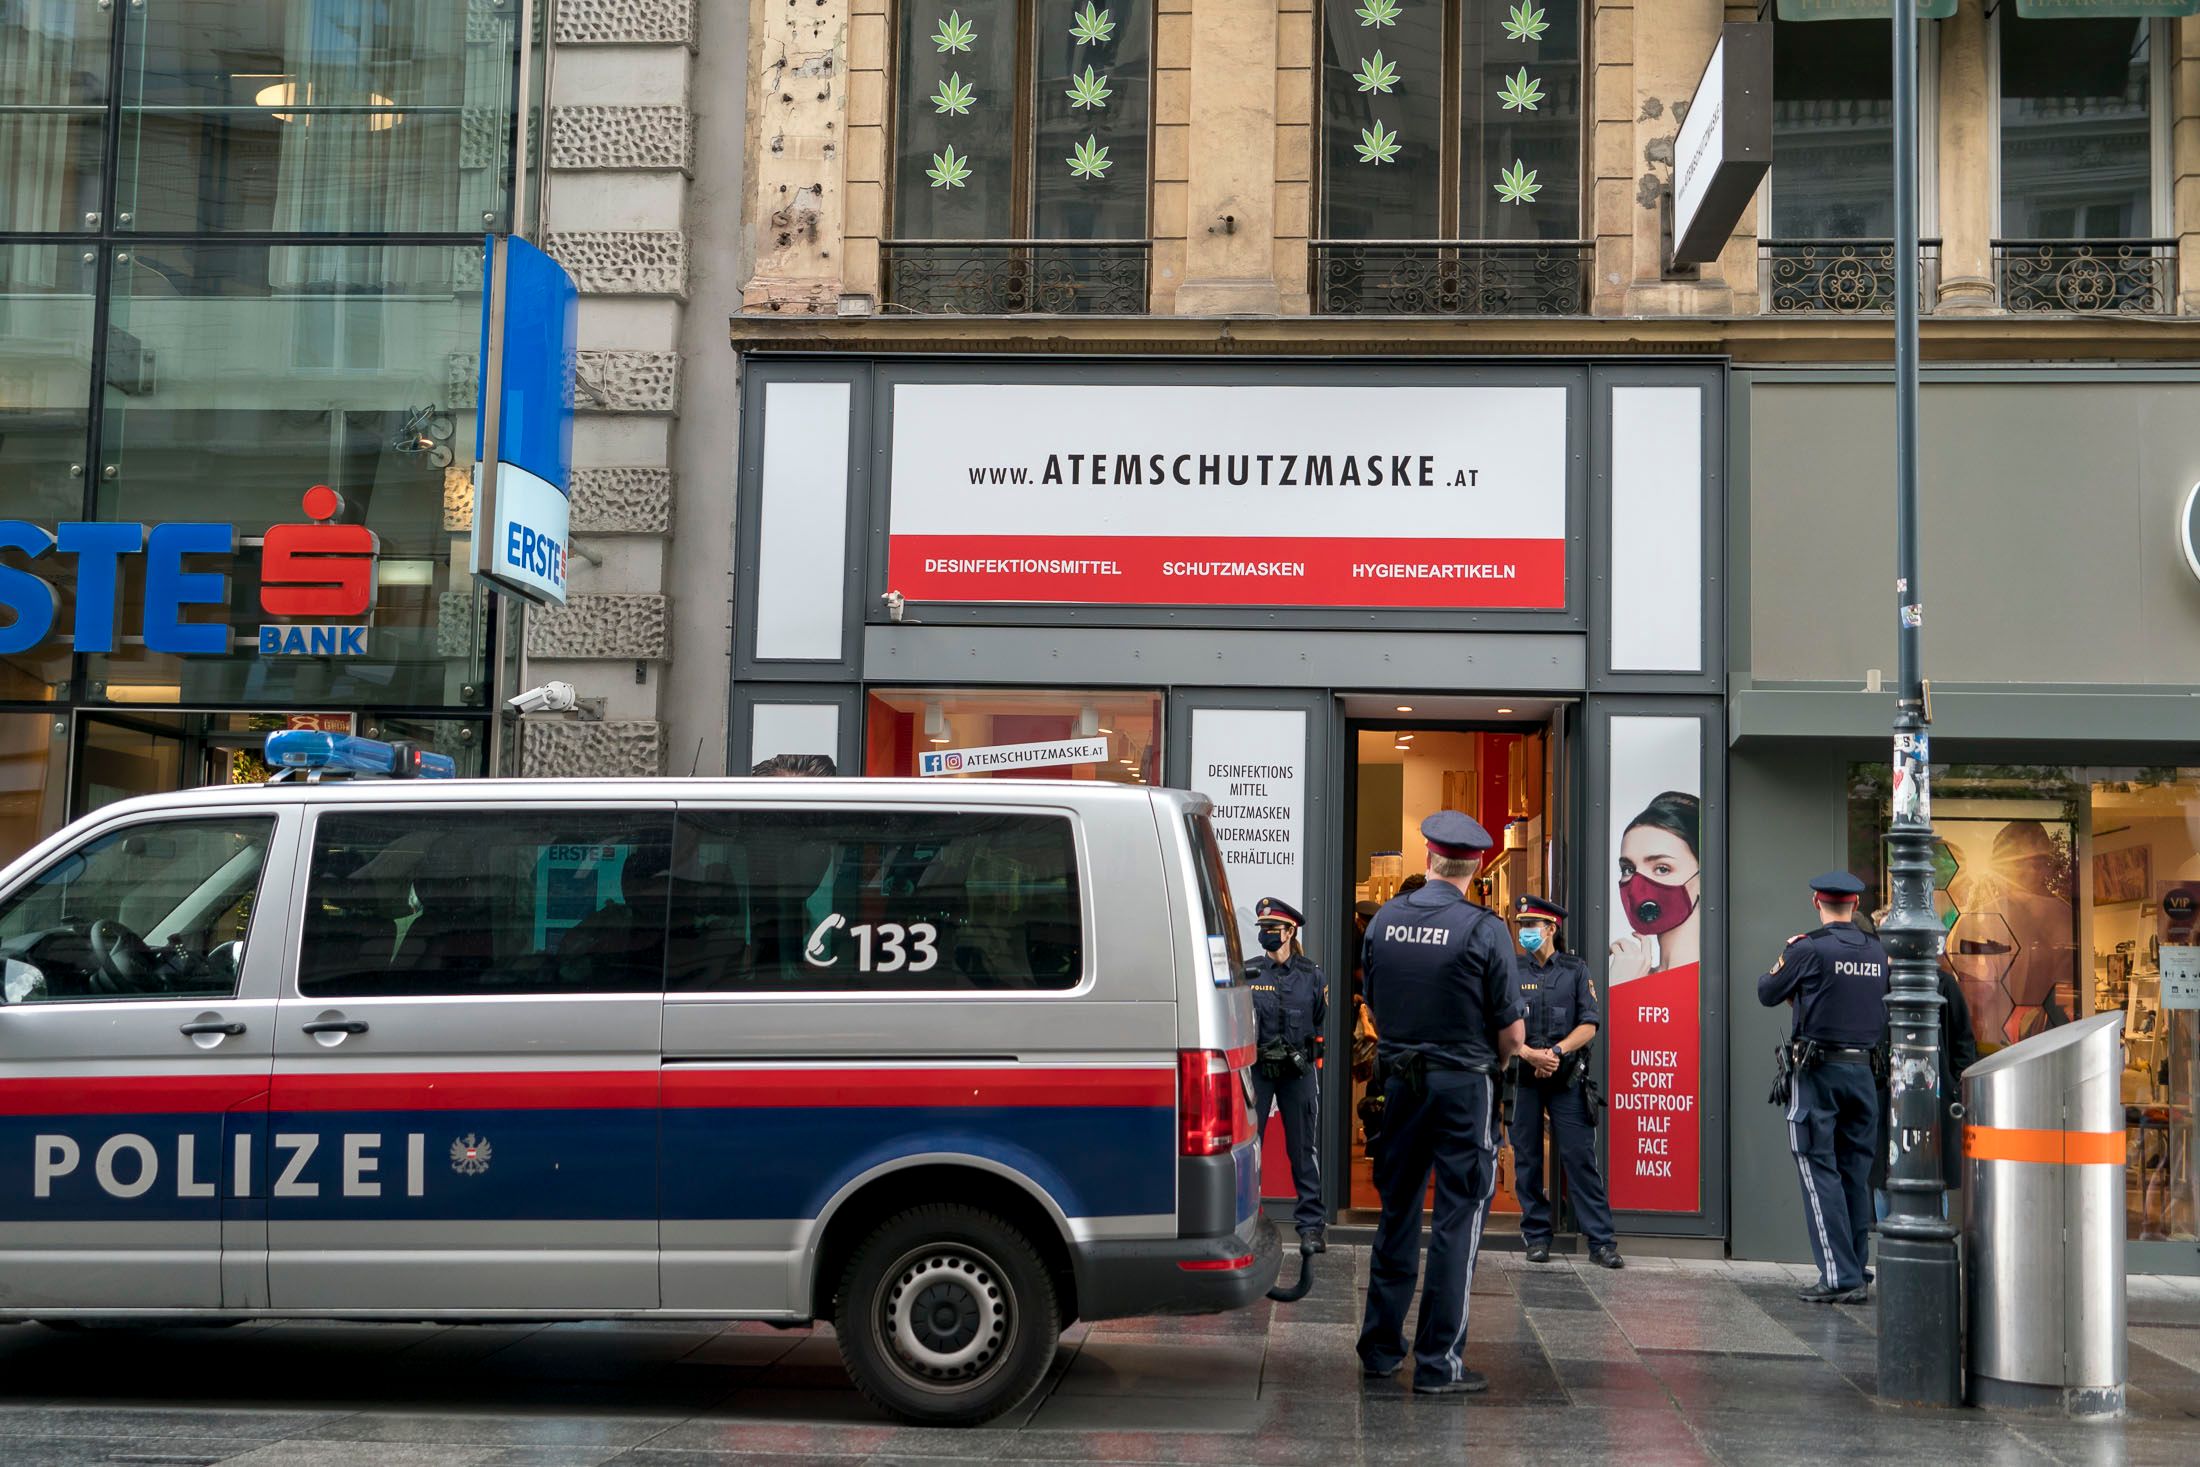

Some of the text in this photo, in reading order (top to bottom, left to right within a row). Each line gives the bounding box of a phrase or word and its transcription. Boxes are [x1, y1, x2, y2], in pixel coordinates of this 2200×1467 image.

[507, 521, 560, 586] ERSTE
[924, 559, 1516, 579] DESINFEKTIONSMITTEL SCHUTZMASKEN HYGIENEARTIKELN
[259, 626, 365, 655] BANK
[966, 745, 1104, 767] ATEMSCHUTZMASKE.AT
[1208, 764, 1294, 779] DESINFEKTIONS
[1229, 783, 1269, 797] MITTEL
[1211, 805, 1291, 820] CHUTZMASKEN
[1214, 827, 1290, 842] NDERMASKEN
[548, 845, 600, 861] ERSTE
[1227, 848, 1295, 866] ERHÄLTLICH!
[2170, 897, 2191, 909] VIP
[1384, 924, 1450, 946] POLIZEI
[849, 922, 939, 973] 133
[1834, 960, 1881, 977] POLIZEI
[1637, 1006, 1670, 1024] FFP3
[1630, 1050, 1678, 1068] UNISEX
[1631, 1071, 1674, 1089] SPORT
[1615, 1093, 1694, 1112] DUSTPROOF
[1637, 1116, 1671, 1133] HALF
[1637, 1137, 1668, 1155] FACE
[34, 1133, 425, 1198] POLIZEI
[1635, 1159, 1672, 1178] MASK
